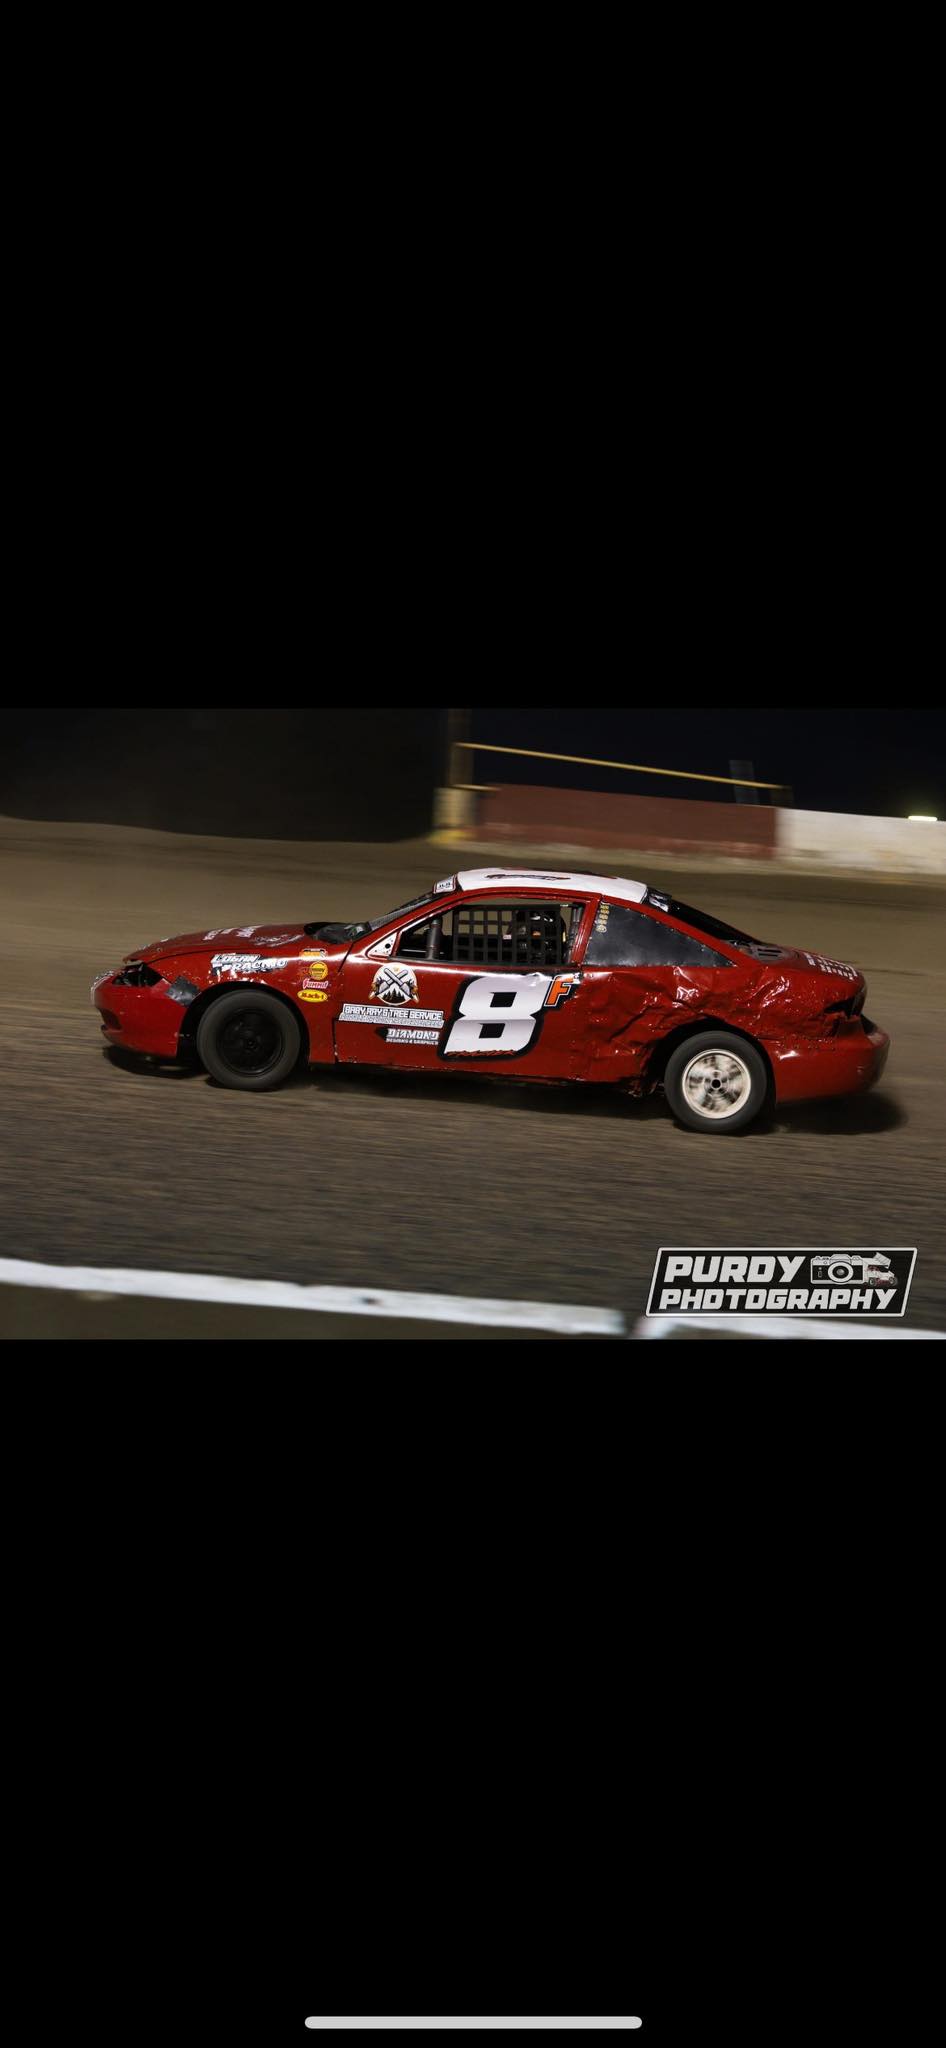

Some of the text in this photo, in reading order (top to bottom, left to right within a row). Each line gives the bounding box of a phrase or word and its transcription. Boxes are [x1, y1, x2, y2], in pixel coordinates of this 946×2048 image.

[344, 1006, 366, 1016] BABY
[389, 1009, 409, 1019] TREE
[409, 1010, 443, 1021] SERVICE
[444, 974, 576, 1055] 8 F
